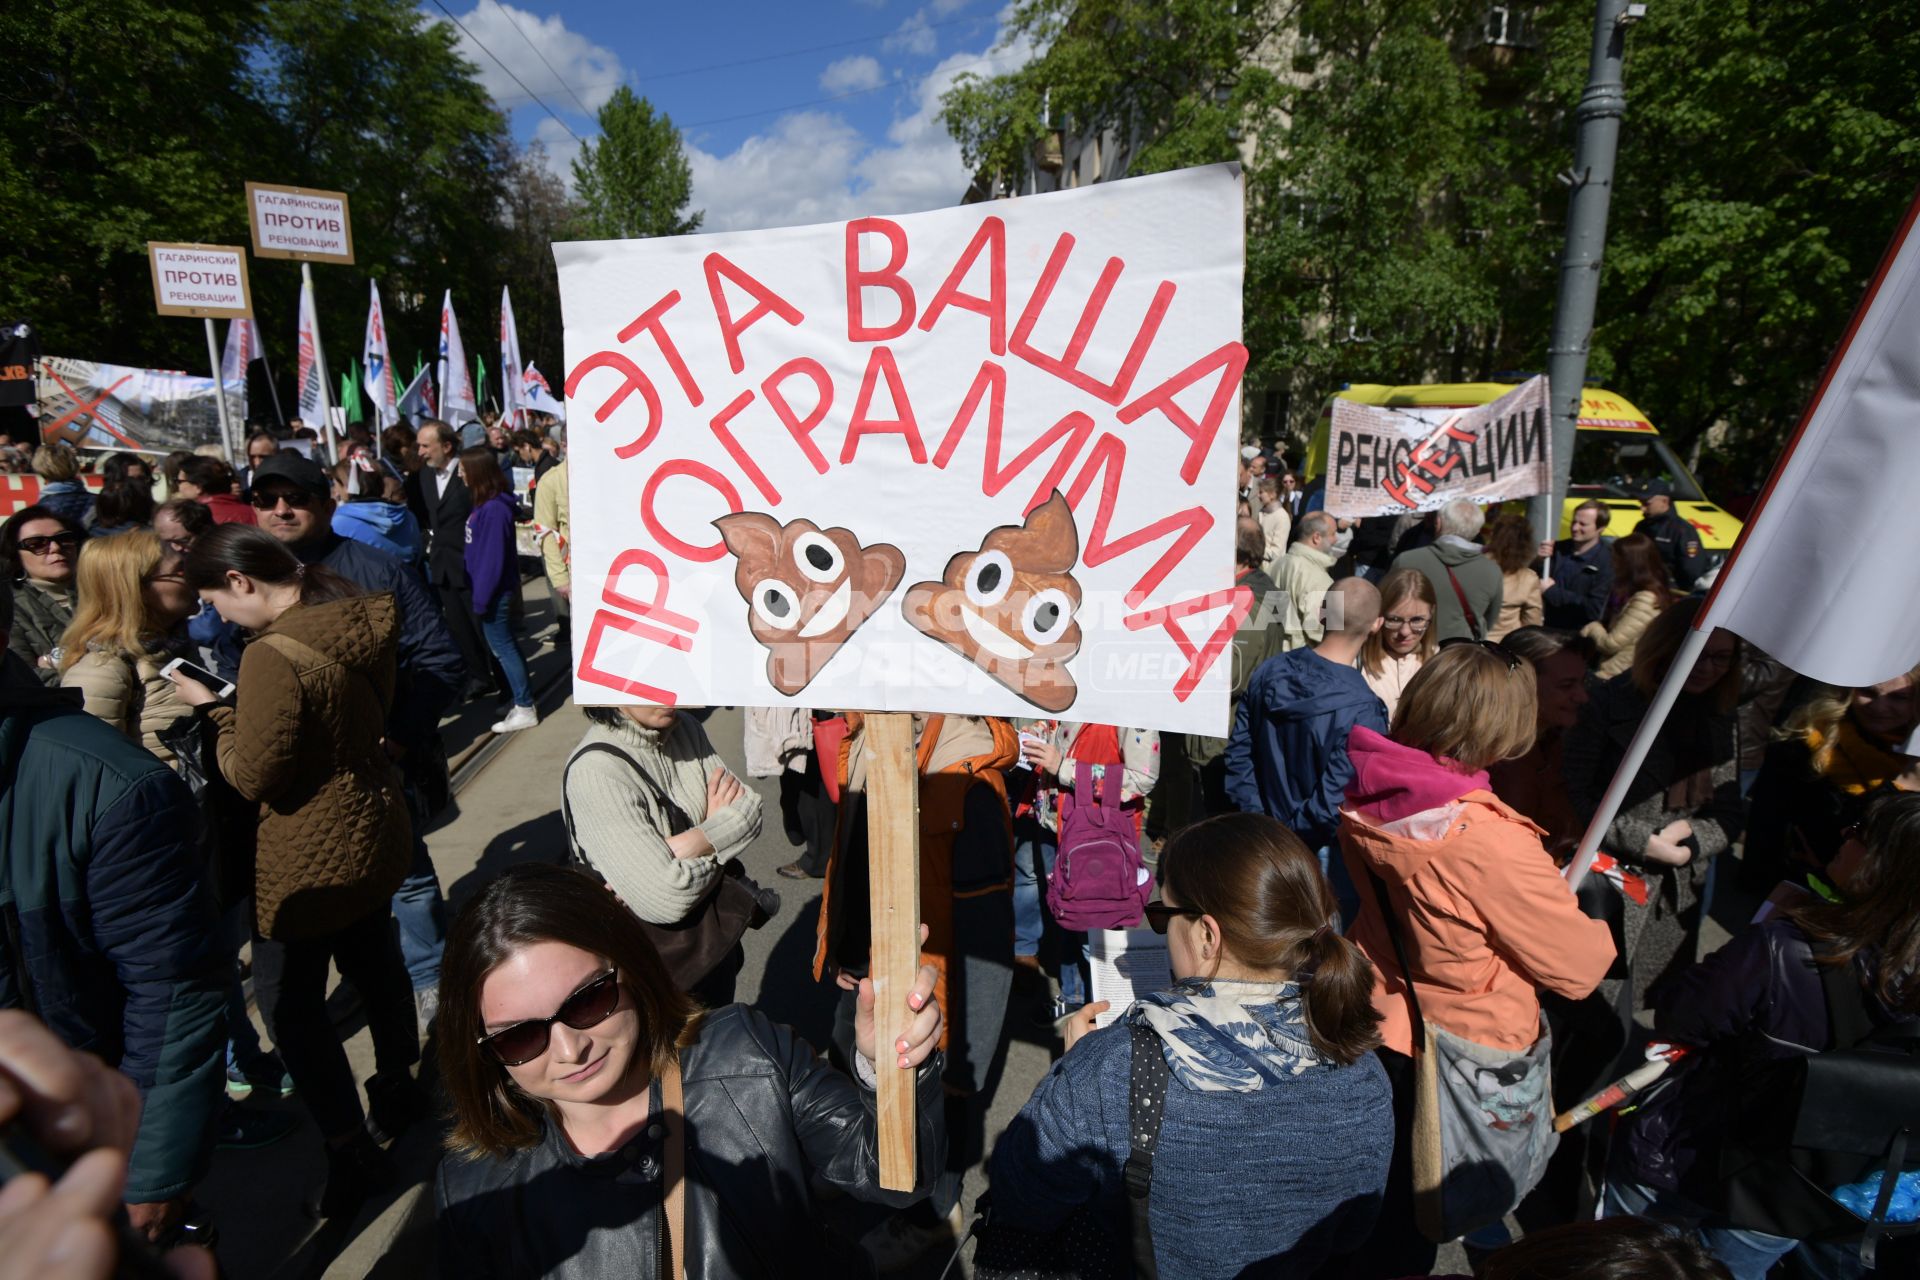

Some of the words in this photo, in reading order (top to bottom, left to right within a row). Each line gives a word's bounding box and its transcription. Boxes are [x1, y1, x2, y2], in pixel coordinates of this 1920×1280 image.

[257, 194, 340, 212] ГАГАРИНСКИЙ
[264, 212, 341, 233] ПРОТИВ
[268, 234, 339, 249] РЕНОВАЦИИ
[158, 252, 237, 265] ГАГАРИНСКИЙ
[165, 270, 238, 287] ПРОТИВ
[169, 290, 237, 303] РЕНОВАЦИИ
[564, 252, 804, 460] ЭТА
[845, 216, 1250, 486] ВАША
[577, 346, 1254, 707] ПРОГРАММА
